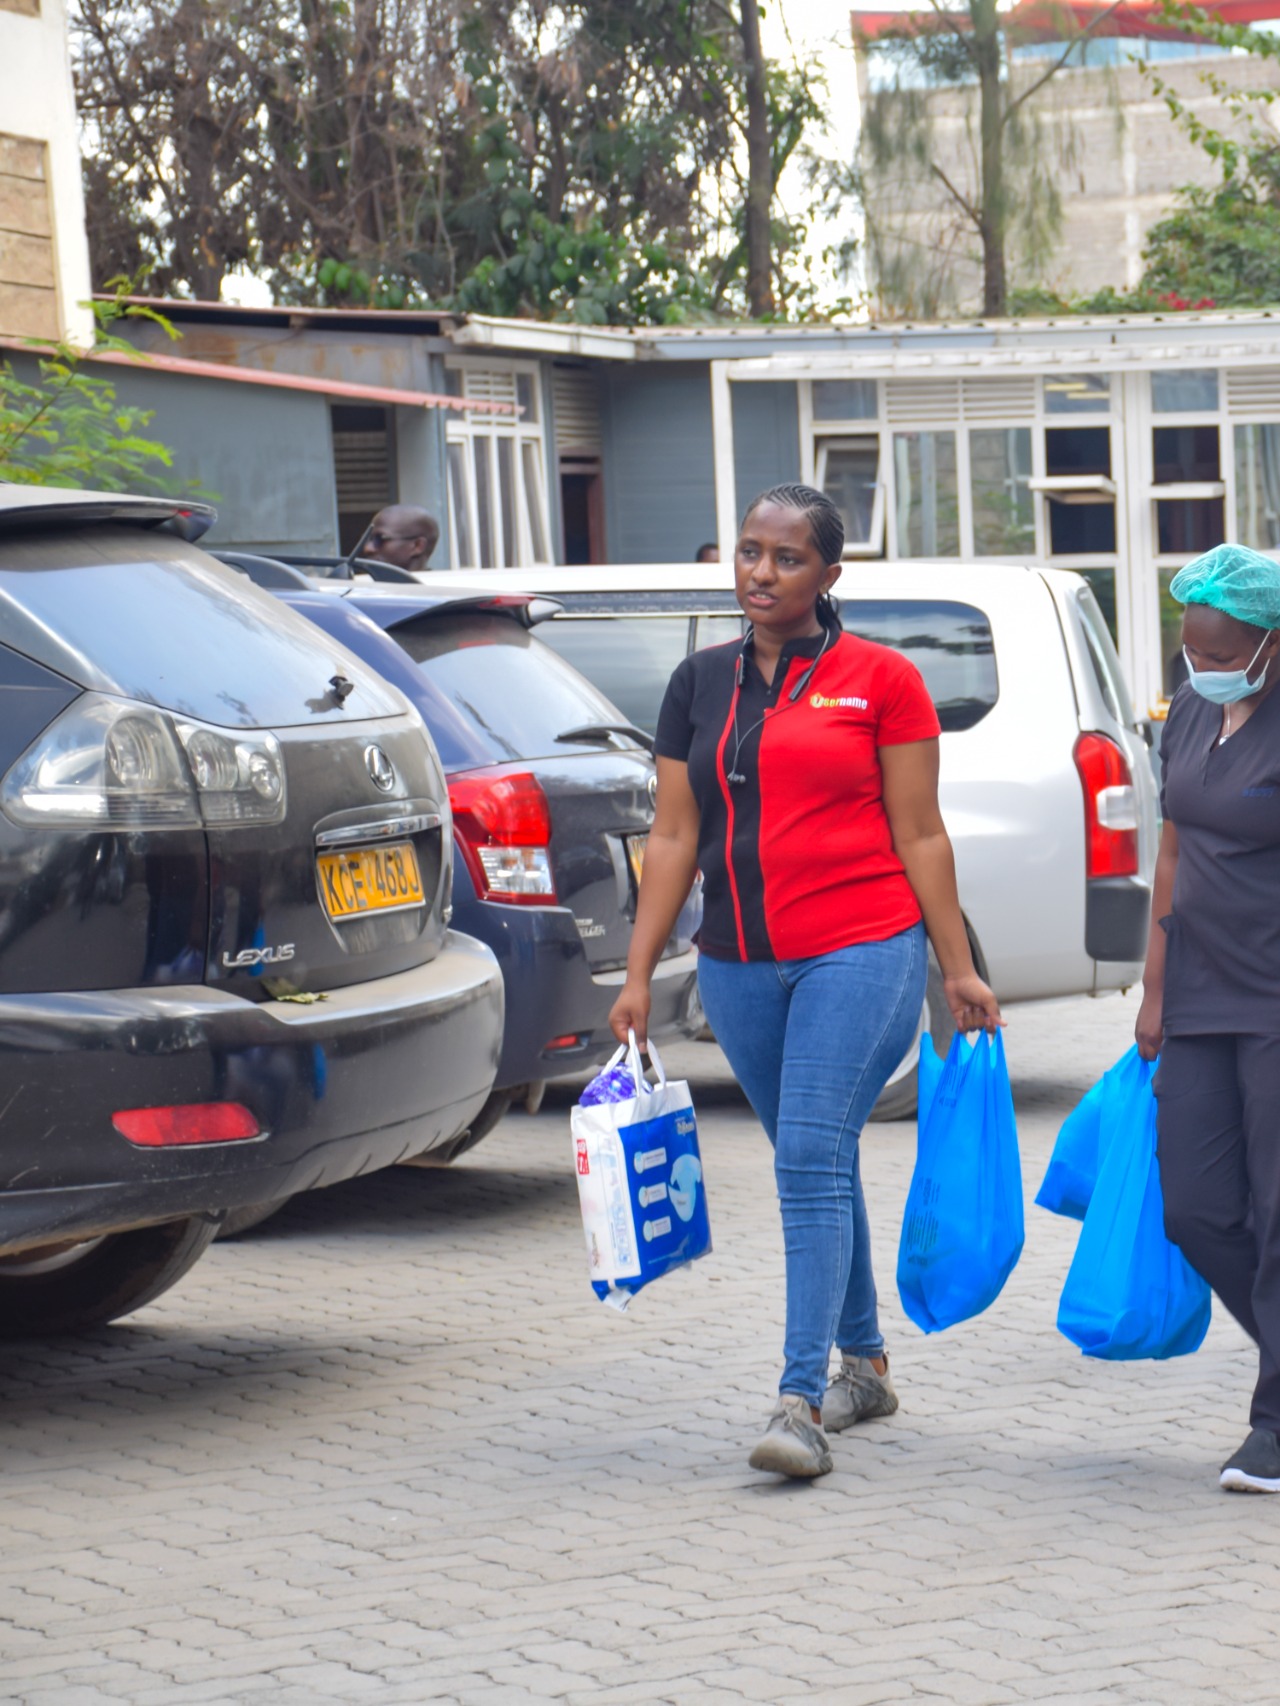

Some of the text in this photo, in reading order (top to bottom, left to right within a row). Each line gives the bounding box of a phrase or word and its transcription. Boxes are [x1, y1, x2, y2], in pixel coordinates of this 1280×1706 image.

[809, 692, 868, 710] Username
[322, 850, 419, 912] KCE 468J
[222, 943, 295, 967] LEXUS
